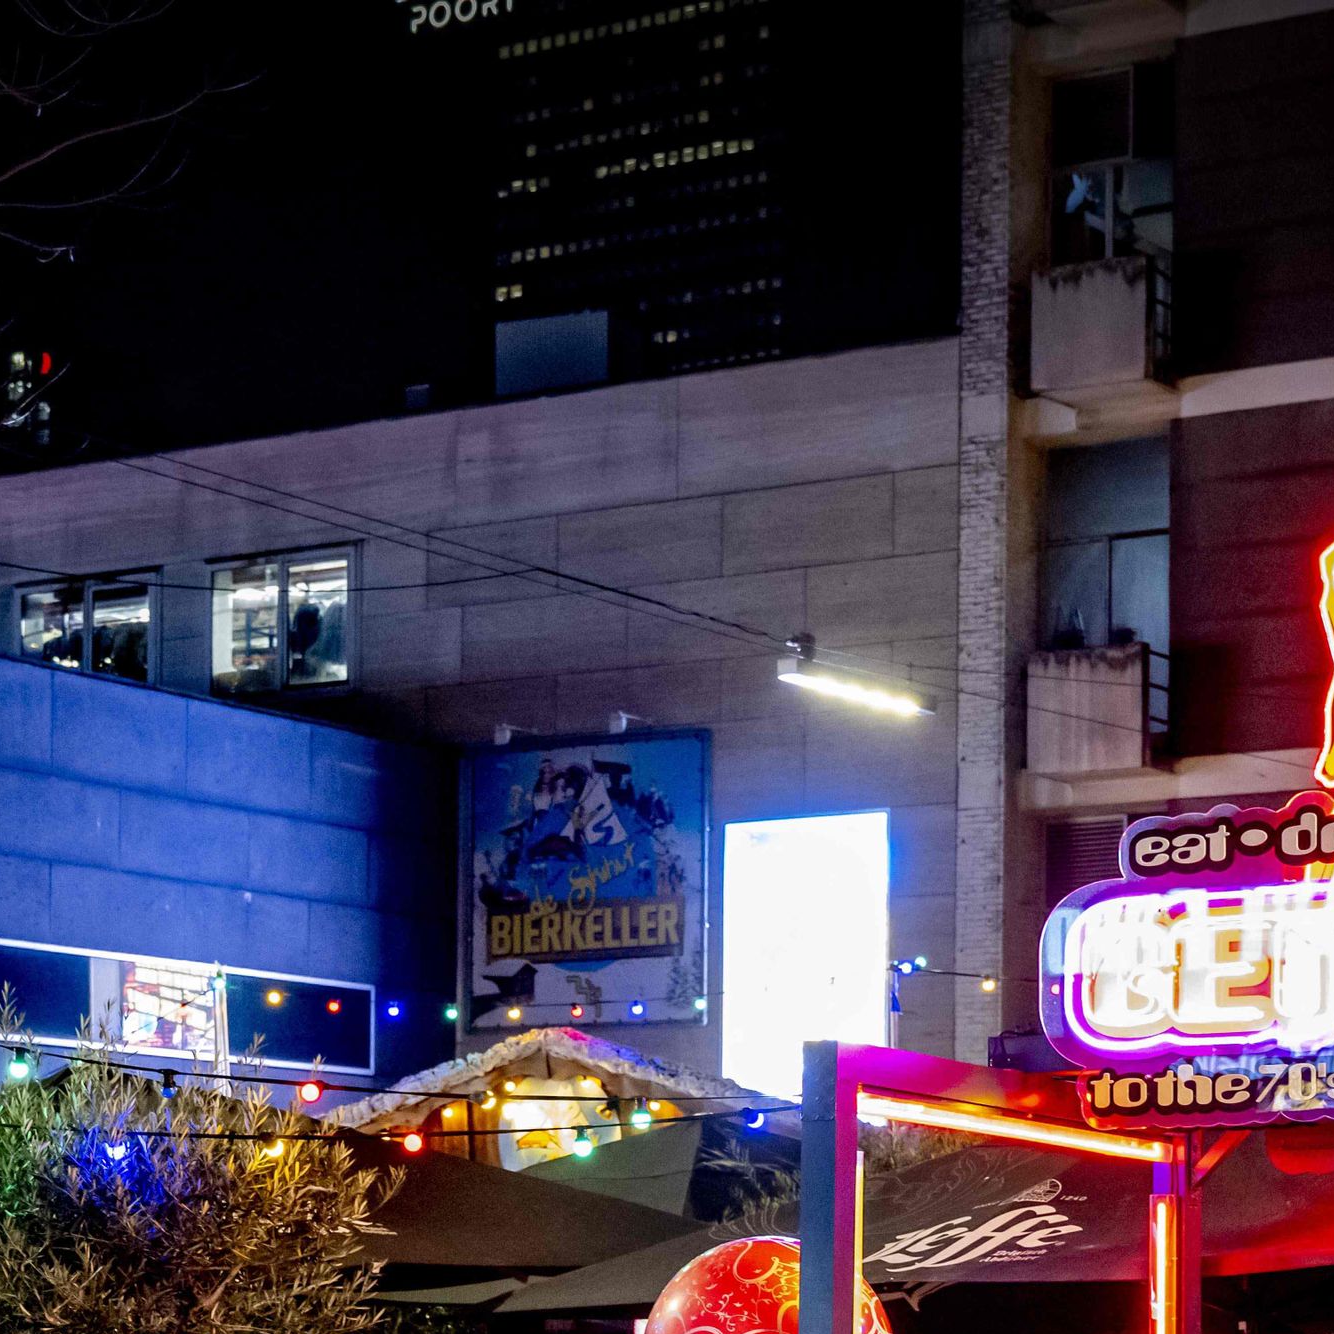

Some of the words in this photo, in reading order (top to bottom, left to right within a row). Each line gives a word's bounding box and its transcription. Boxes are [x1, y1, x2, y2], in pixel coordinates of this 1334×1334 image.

[1135, 824, 1230, 867] eat
[490, 903, 681, 956] BIERKELLER
[1091, 1073, 1148, 1109] to
[1154, 1064, 1251, 1107] the
[862, 1204, 1084, 1273] Leffe
